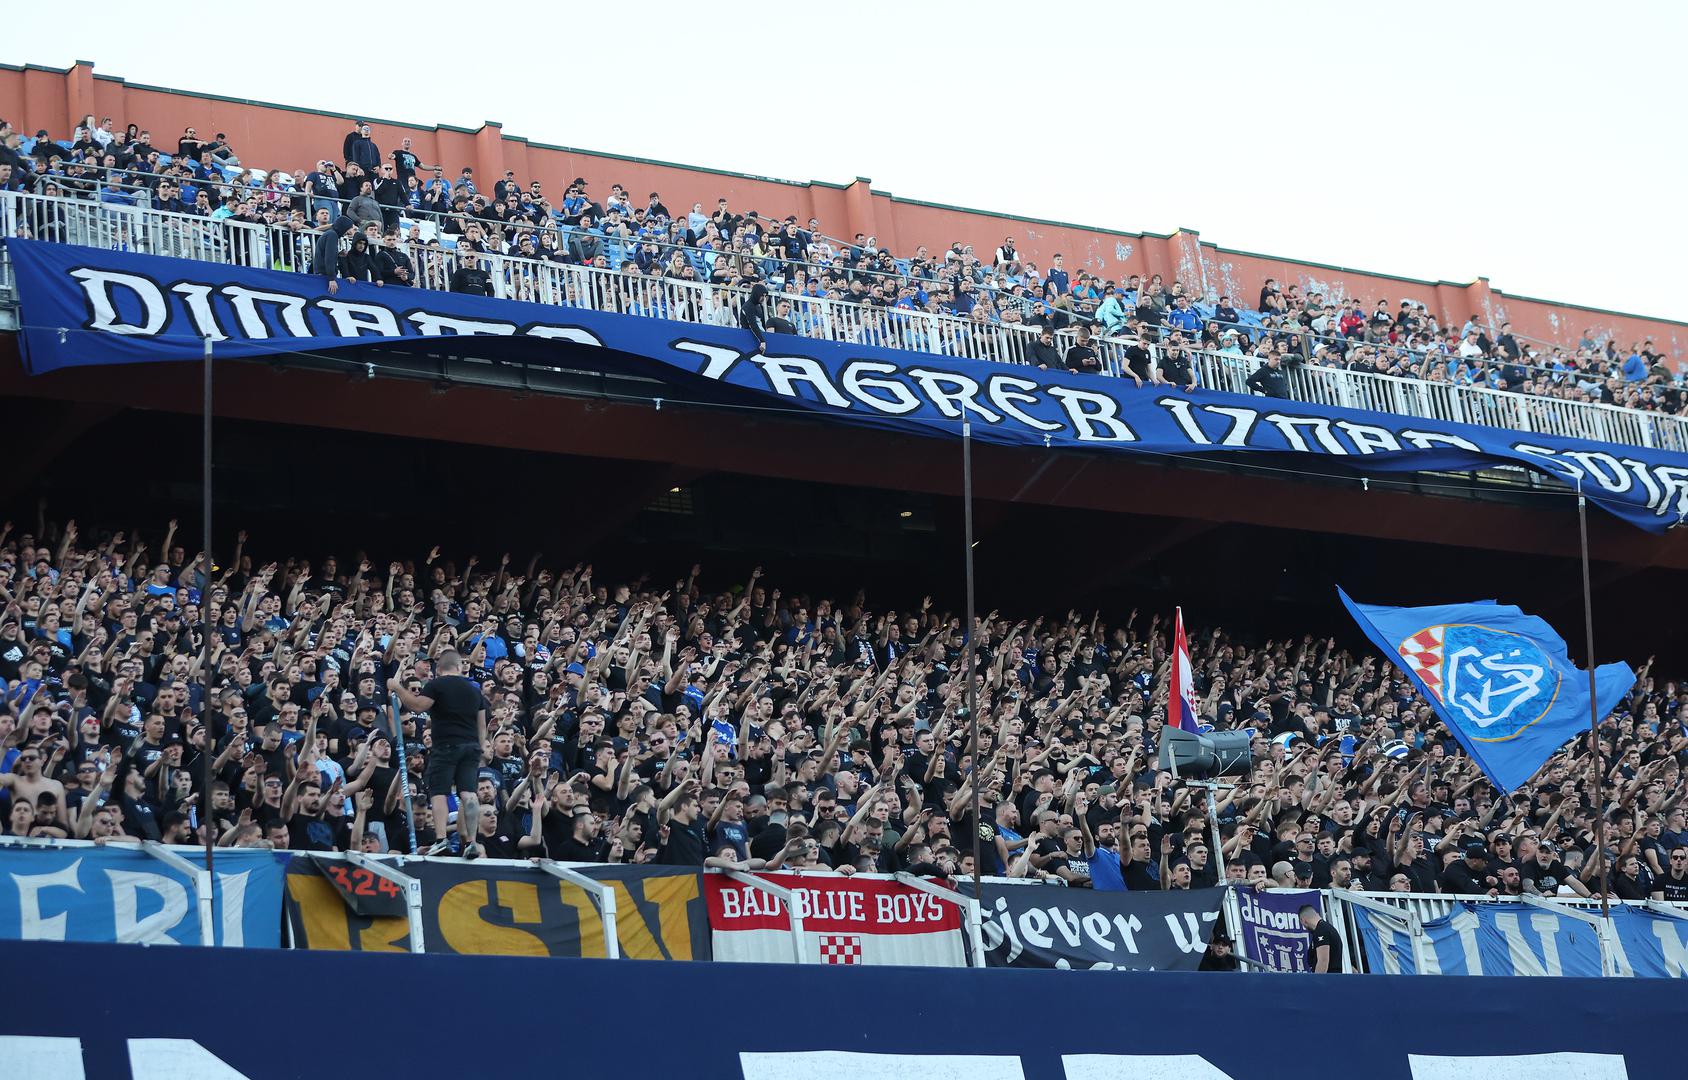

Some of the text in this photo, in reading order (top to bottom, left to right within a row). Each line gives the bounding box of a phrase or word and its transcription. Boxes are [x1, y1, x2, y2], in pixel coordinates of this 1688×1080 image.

[675, 341, 1137, 442] ZAGREB
[328, 865, 401, 898] 324
[719, 886, 944, 924] BAD BLUE BOYS
[1241, 892, 1308, 931] dinam
[1164, 910, 1220, 954] u
